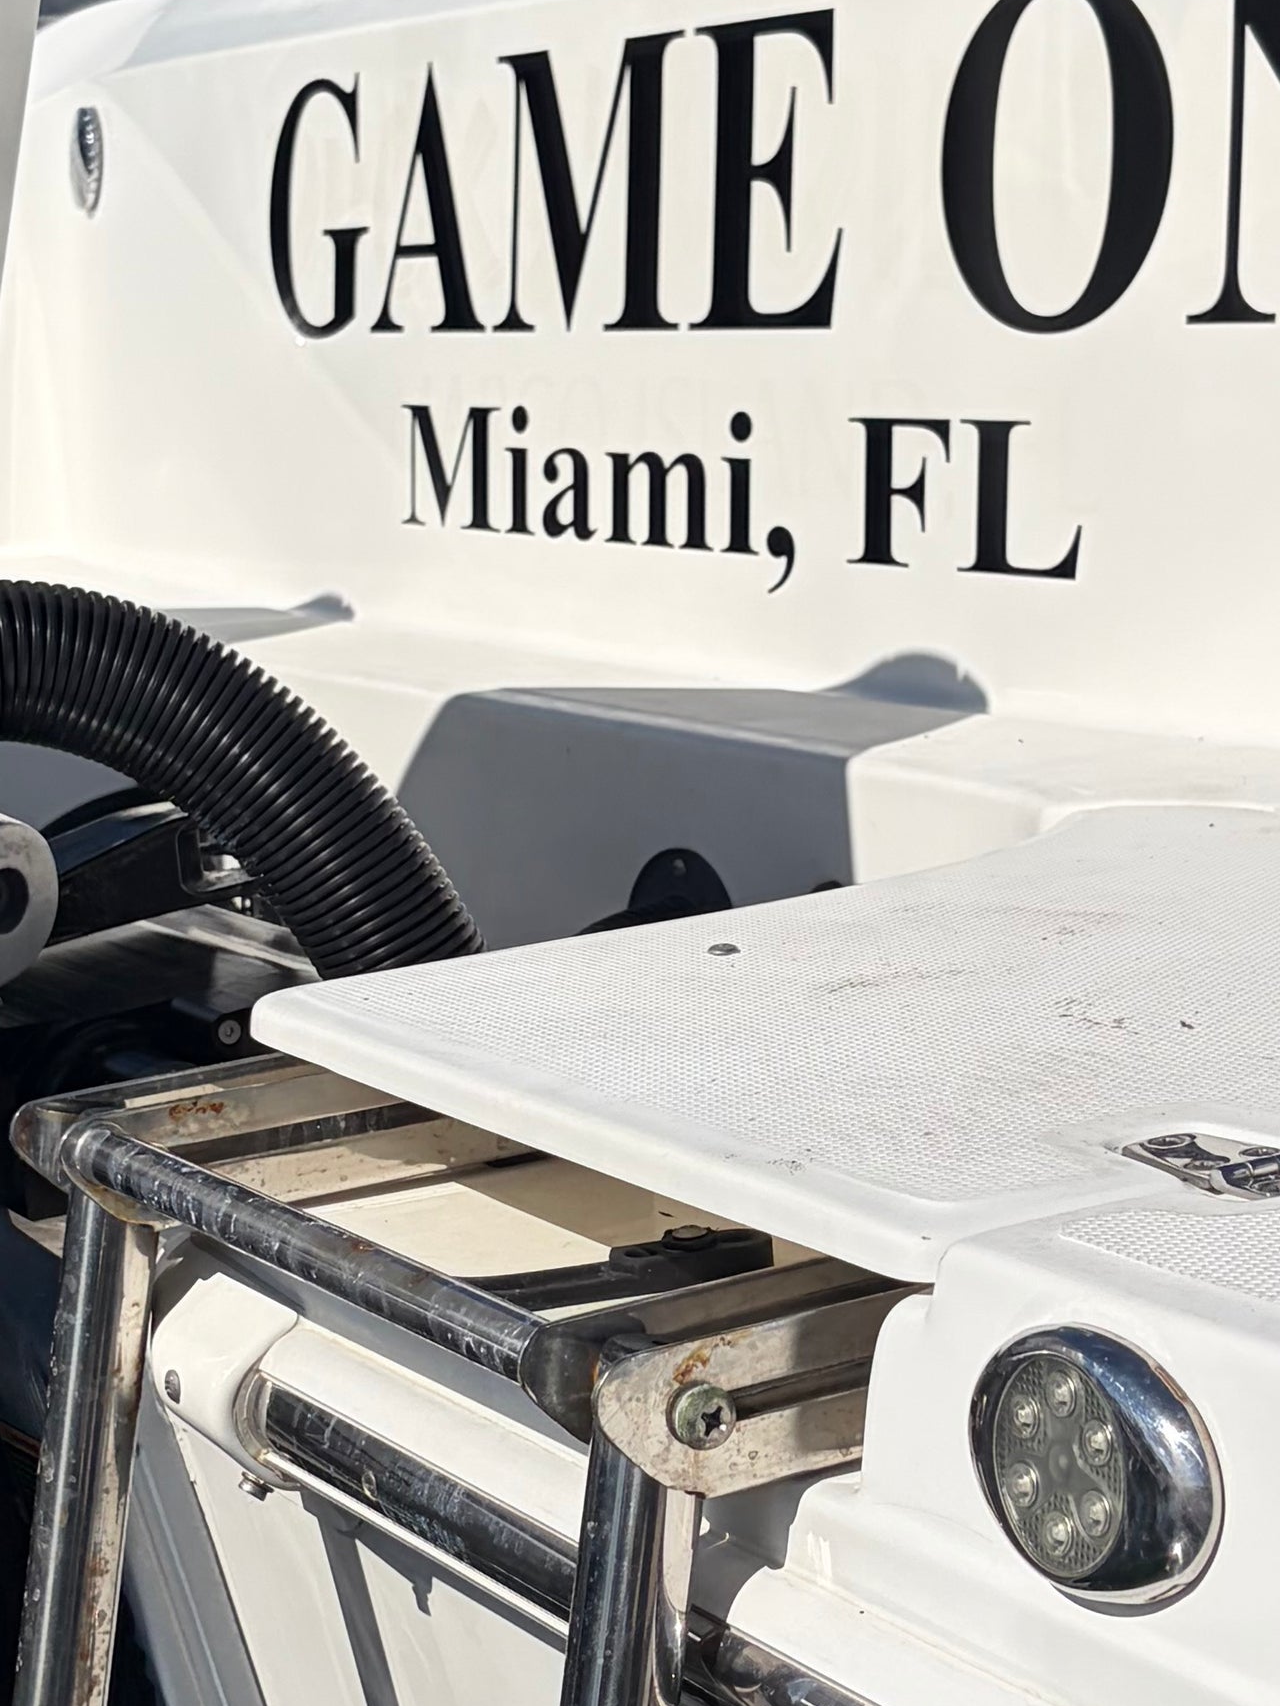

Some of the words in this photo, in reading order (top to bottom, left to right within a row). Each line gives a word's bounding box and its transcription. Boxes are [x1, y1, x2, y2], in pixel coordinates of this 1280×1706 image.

[270, 9, 841, 337] GAME
[405, 405, 794, 592] Miami,
[848, 418, 1081, 579] FL
